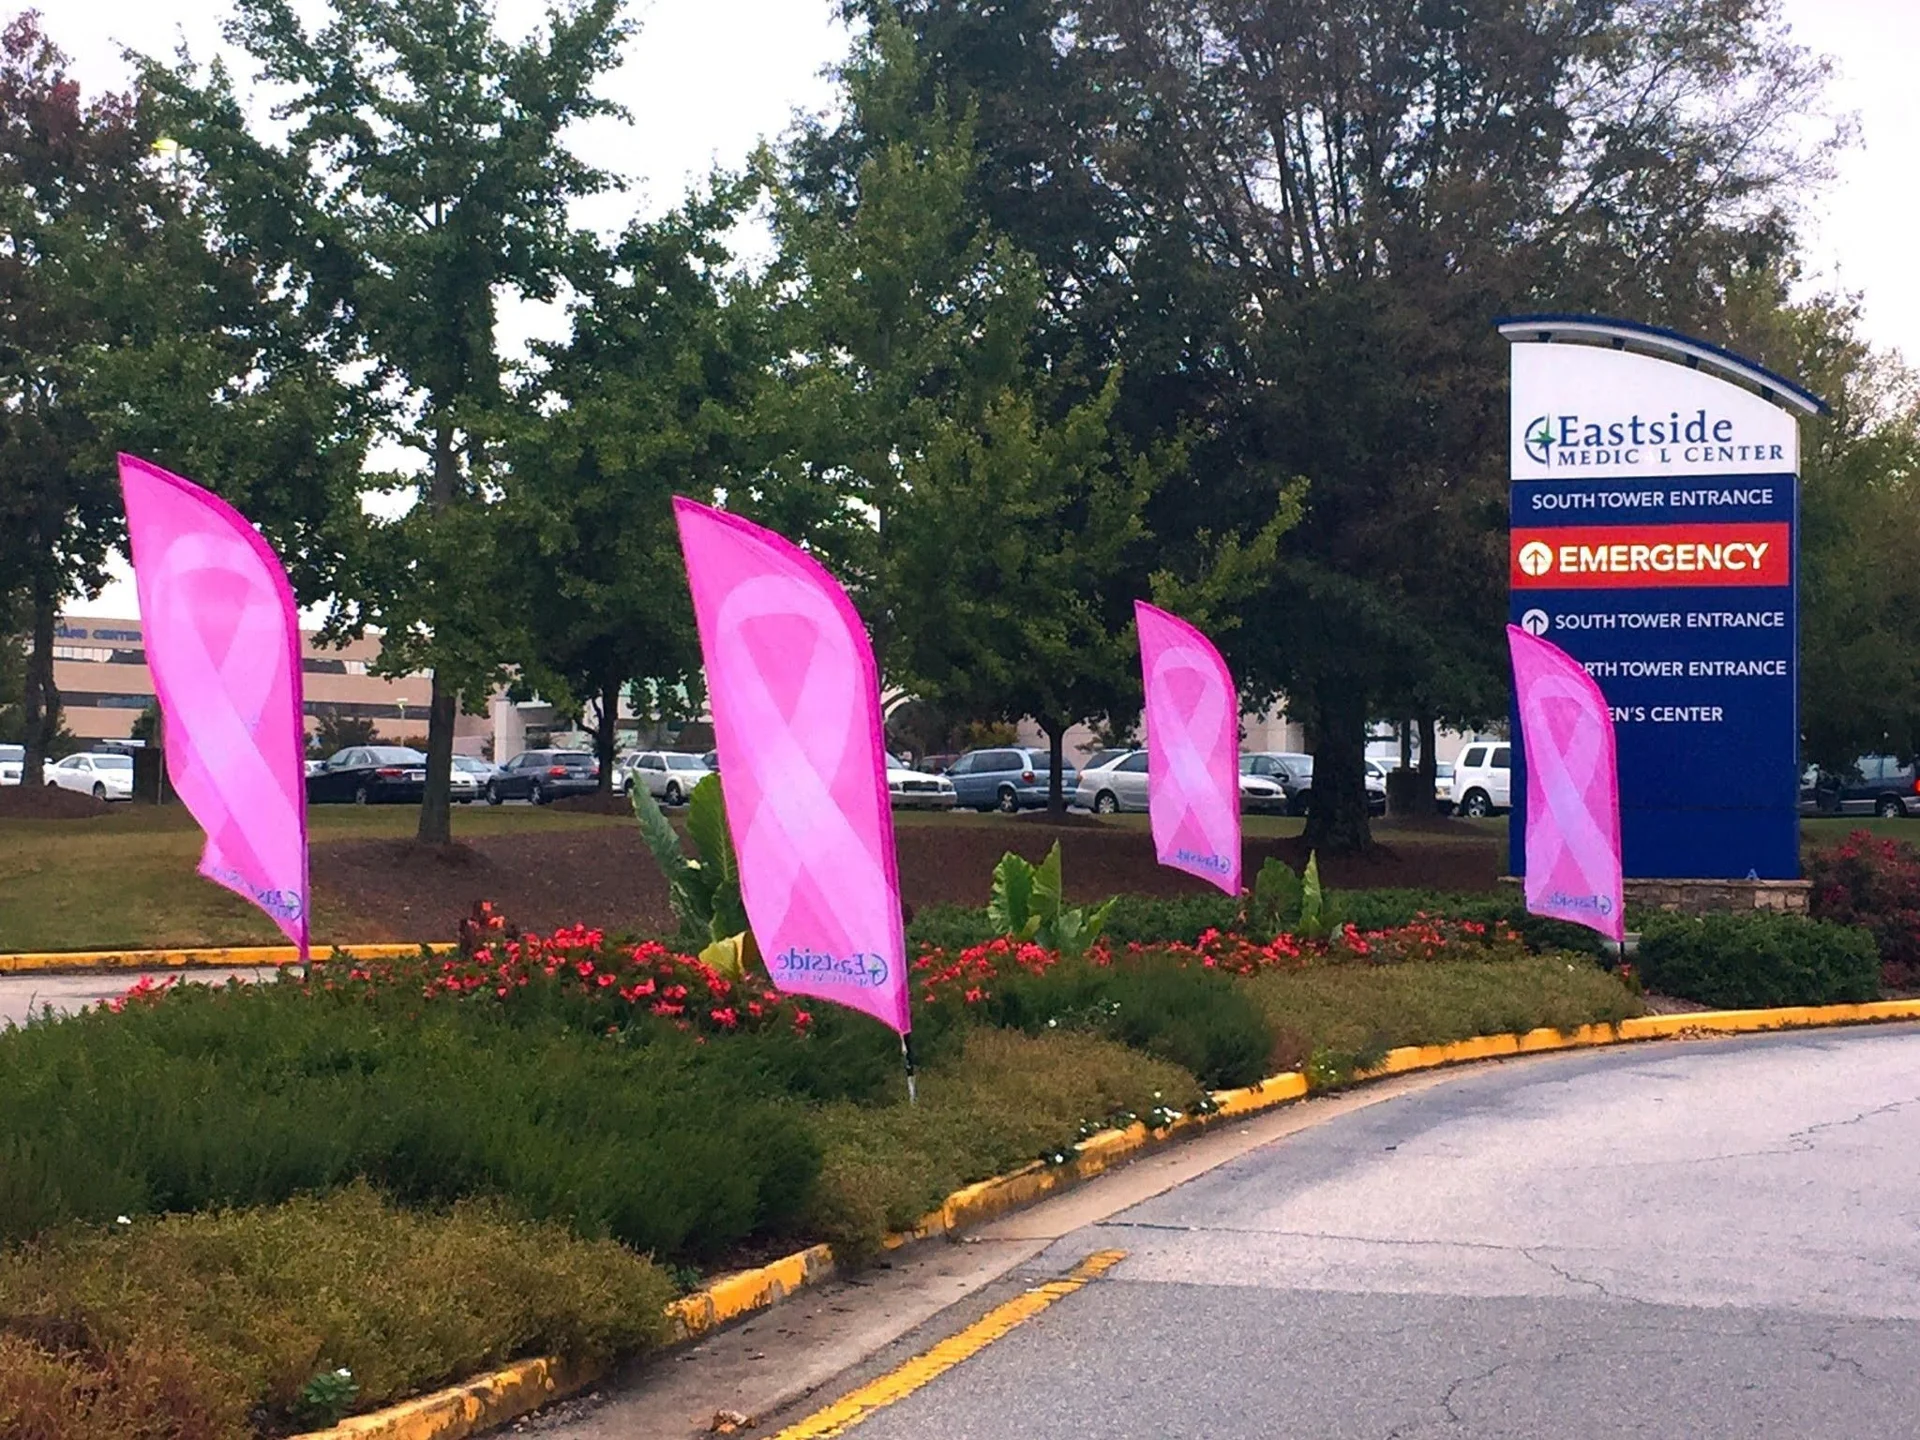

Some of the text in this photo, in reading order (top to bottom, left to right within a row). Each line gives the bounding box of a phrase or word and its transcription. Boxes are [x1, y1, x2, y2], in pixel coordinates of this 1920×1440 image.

[1558, 410, 1733, 447] Eastside
[1557, 444, 1784, 466] MEDICL CENTER
[1532, 488, 1773, 510] SOUTH TOWER ENTRANCE
[1559, 542, 1769, 573] EMERGENCY
[1555, 612, 1784, 630] SOUTH TOWER ENTRANCE
[1579, 661, 1787, 677] RTH TOWER ENTRANCE
[1608, 706, 1723, 722] EN'S CENTER
